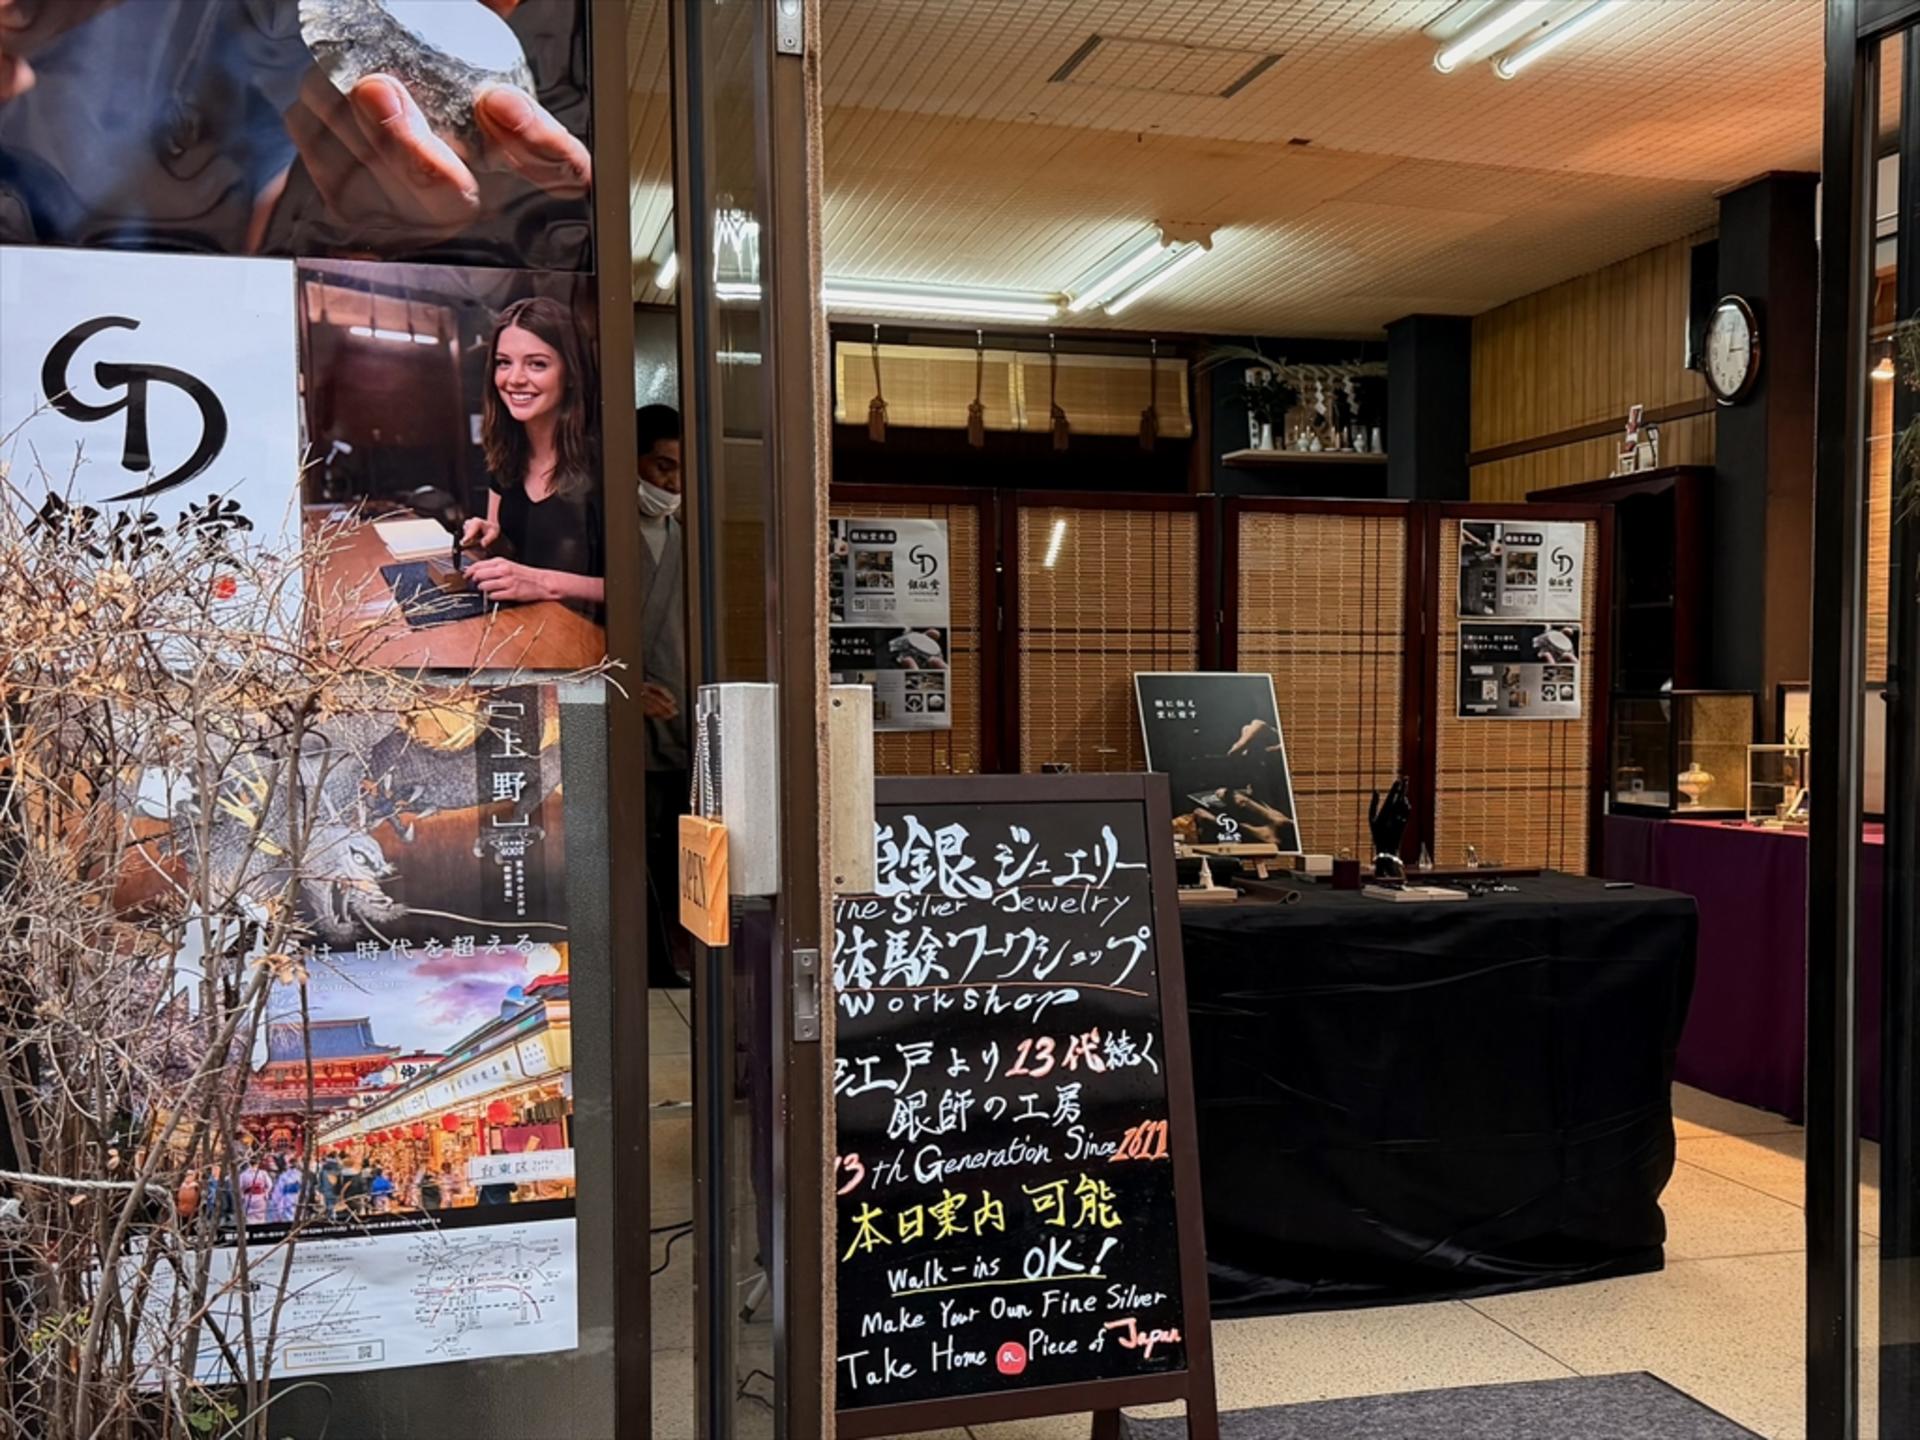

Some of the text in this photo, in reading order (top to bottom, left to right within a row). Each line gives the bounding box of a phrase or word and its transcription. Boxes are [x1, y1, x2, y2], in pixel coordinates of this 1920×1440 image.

[894, 892, 968, 924] Silver
[992, 885, 1130, 927] Jewelry
[886, 1082, 1083, 1143] 銀師の工房
[914, 1134, 1052, 1184] Generation
[1022, 1173, 1122, 1228] 可能
[887, 1258, 1001, 1292] Walk-ins
[861, 1307, 926, 1337] Make
[940, 1299, 980, 1328] Your
[1042, 1290, 1097, 1318] Fine
[1106, 1283, 1167, 1310] Silver
[837, 1348, 918, 1389] Take
[932, 1335, 988, 1372] Home
[1029, 1328, 1078, 1361] Piece
[1088, 1330, 1107, 1353] of
[1103, 1317, 1182, 1359] Japan
